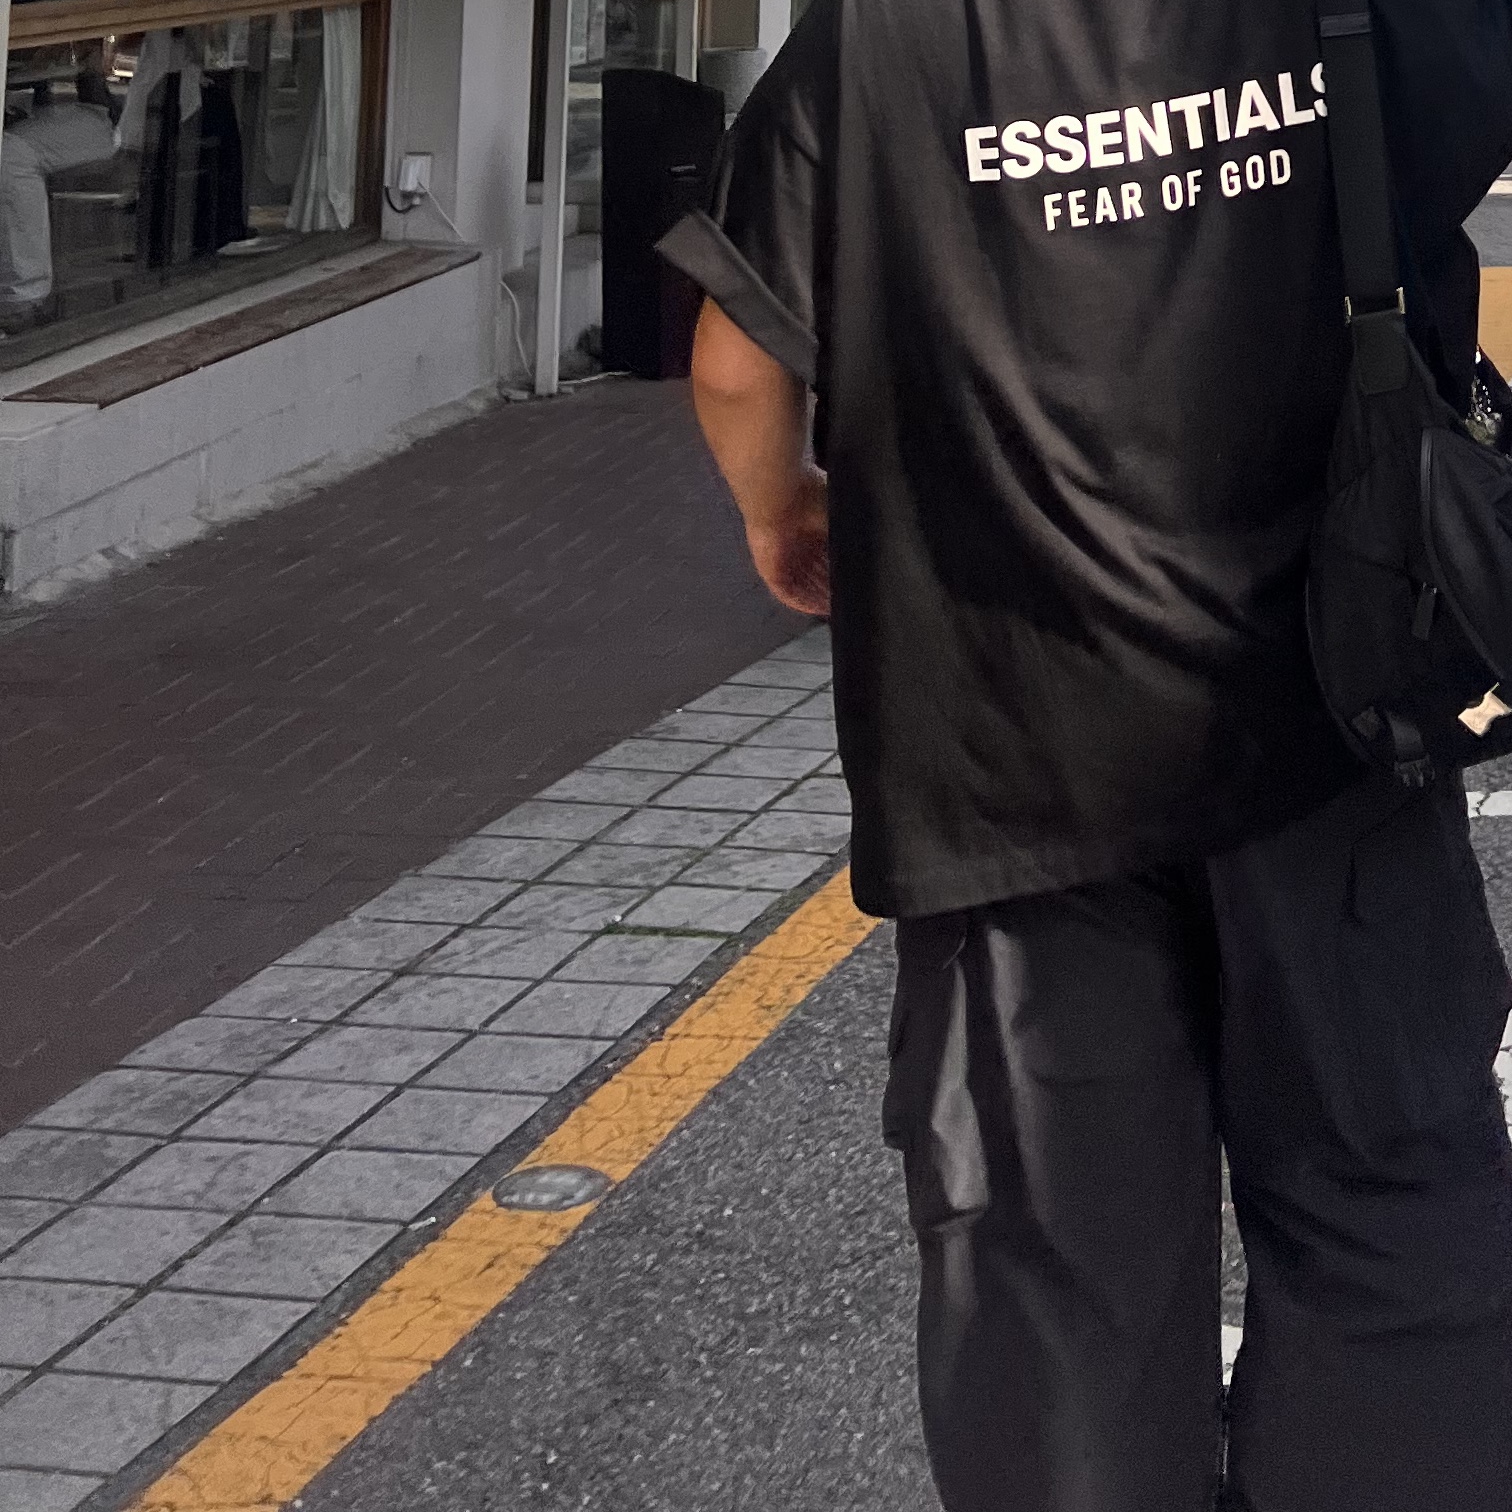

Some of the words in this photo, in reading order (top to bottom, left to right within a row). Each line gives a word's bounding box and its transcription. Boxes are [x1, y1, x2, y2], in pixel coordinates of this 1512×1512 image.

[1043, 181, 1145, 231] FEAR
[1161, 169, 1204, 211] OF
[1219, 148, 1292, 198] GOD
